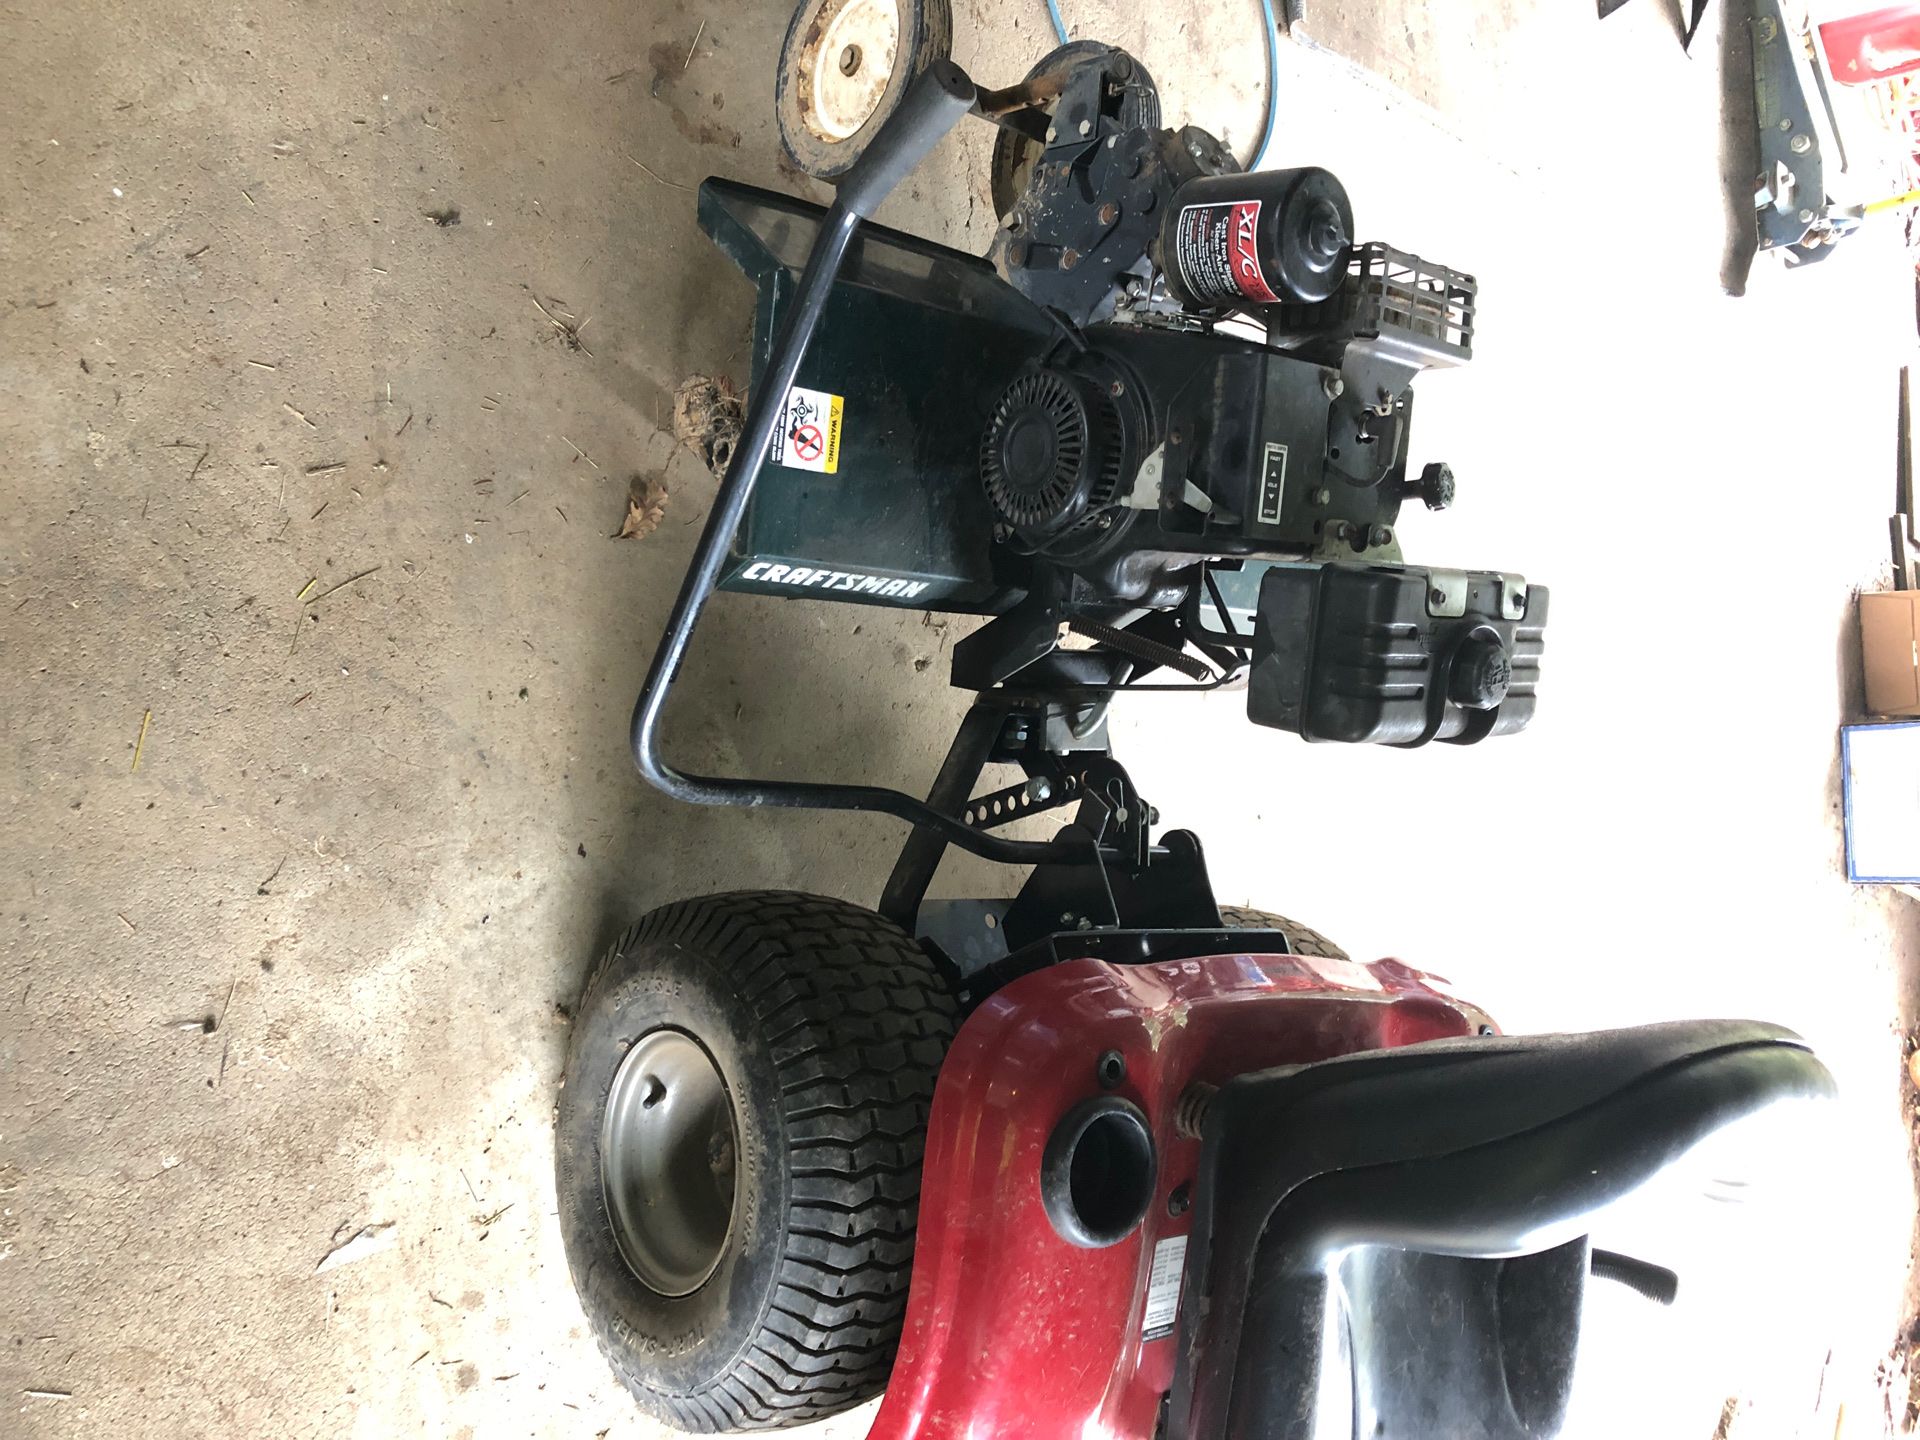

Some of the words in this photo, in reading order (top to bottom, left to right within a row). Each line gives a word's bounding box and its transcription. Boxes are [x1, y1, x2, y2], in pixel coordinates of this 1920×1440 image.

[1238, 206, 1258, 279] XL/C
[1224, 263, 1238, 290] Sleeve
[828, 419, 838, 463] WARNING
[741, 562, 931, 598] CRAFTSMAN
